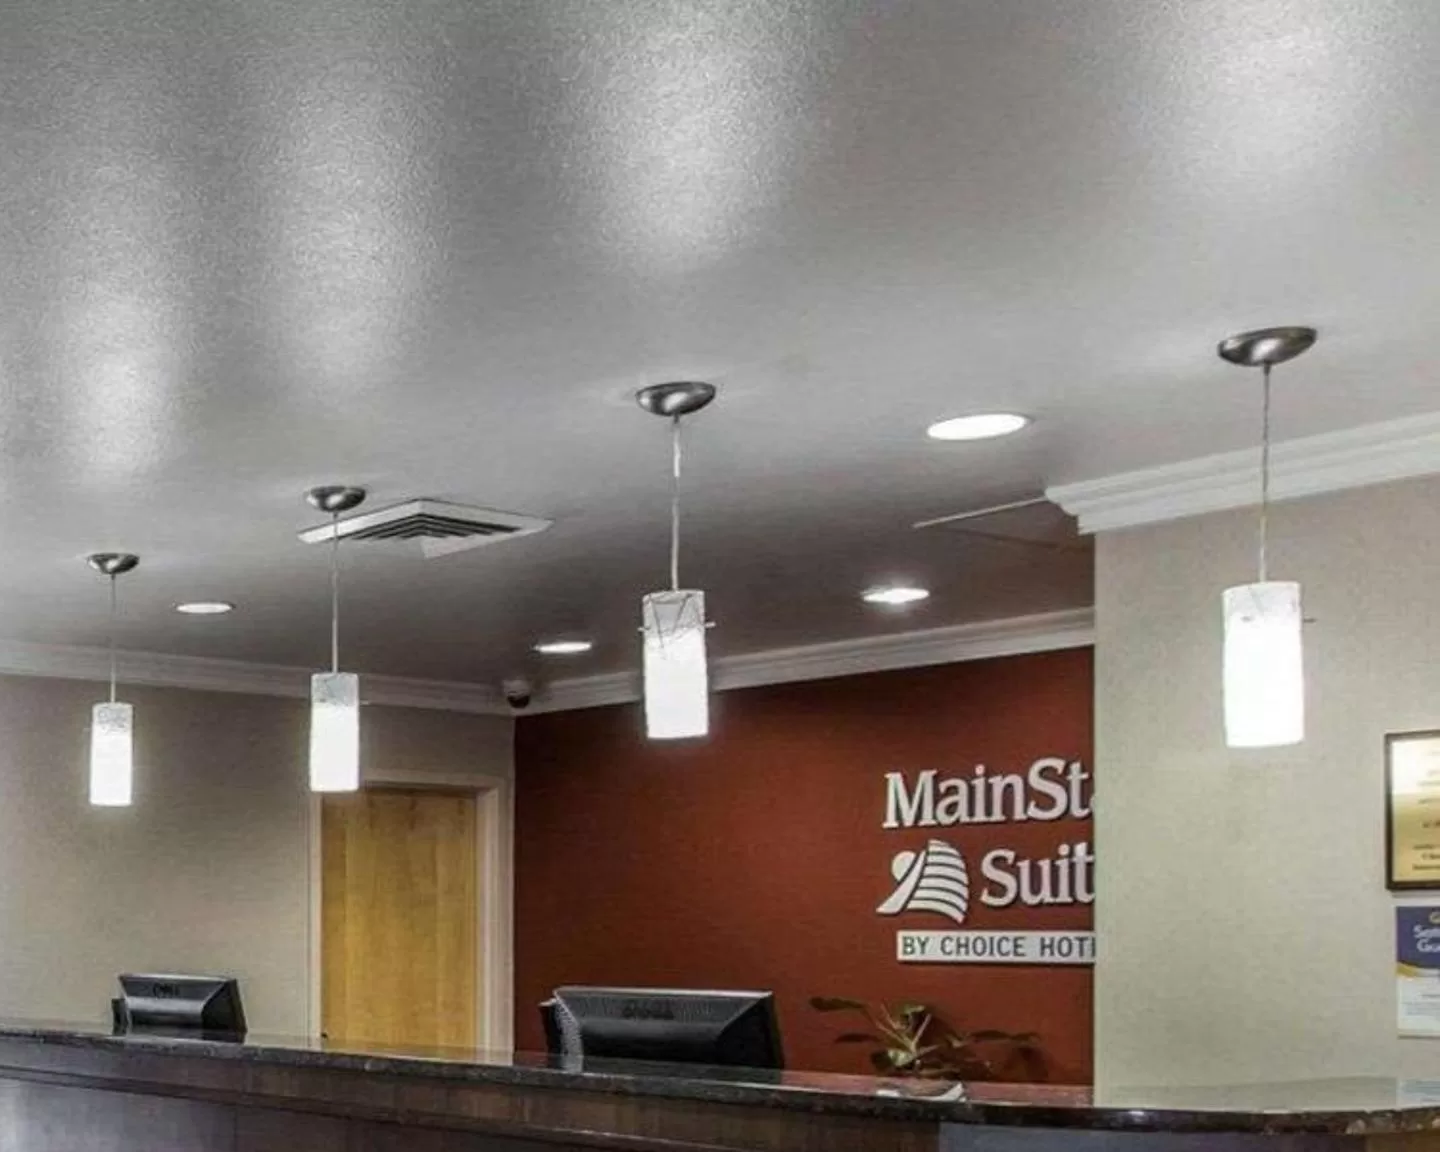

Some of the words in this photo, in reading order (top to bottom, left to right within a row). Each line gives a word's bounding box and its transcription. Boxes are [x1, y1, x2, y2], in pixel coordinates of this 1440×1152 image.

[882, 757, 1095, 829] MainSt
[980, 841, 1095, 907] Suit
[901, 936, 930, 956] BY
[940, 936, 1027, 957] CHOICE
